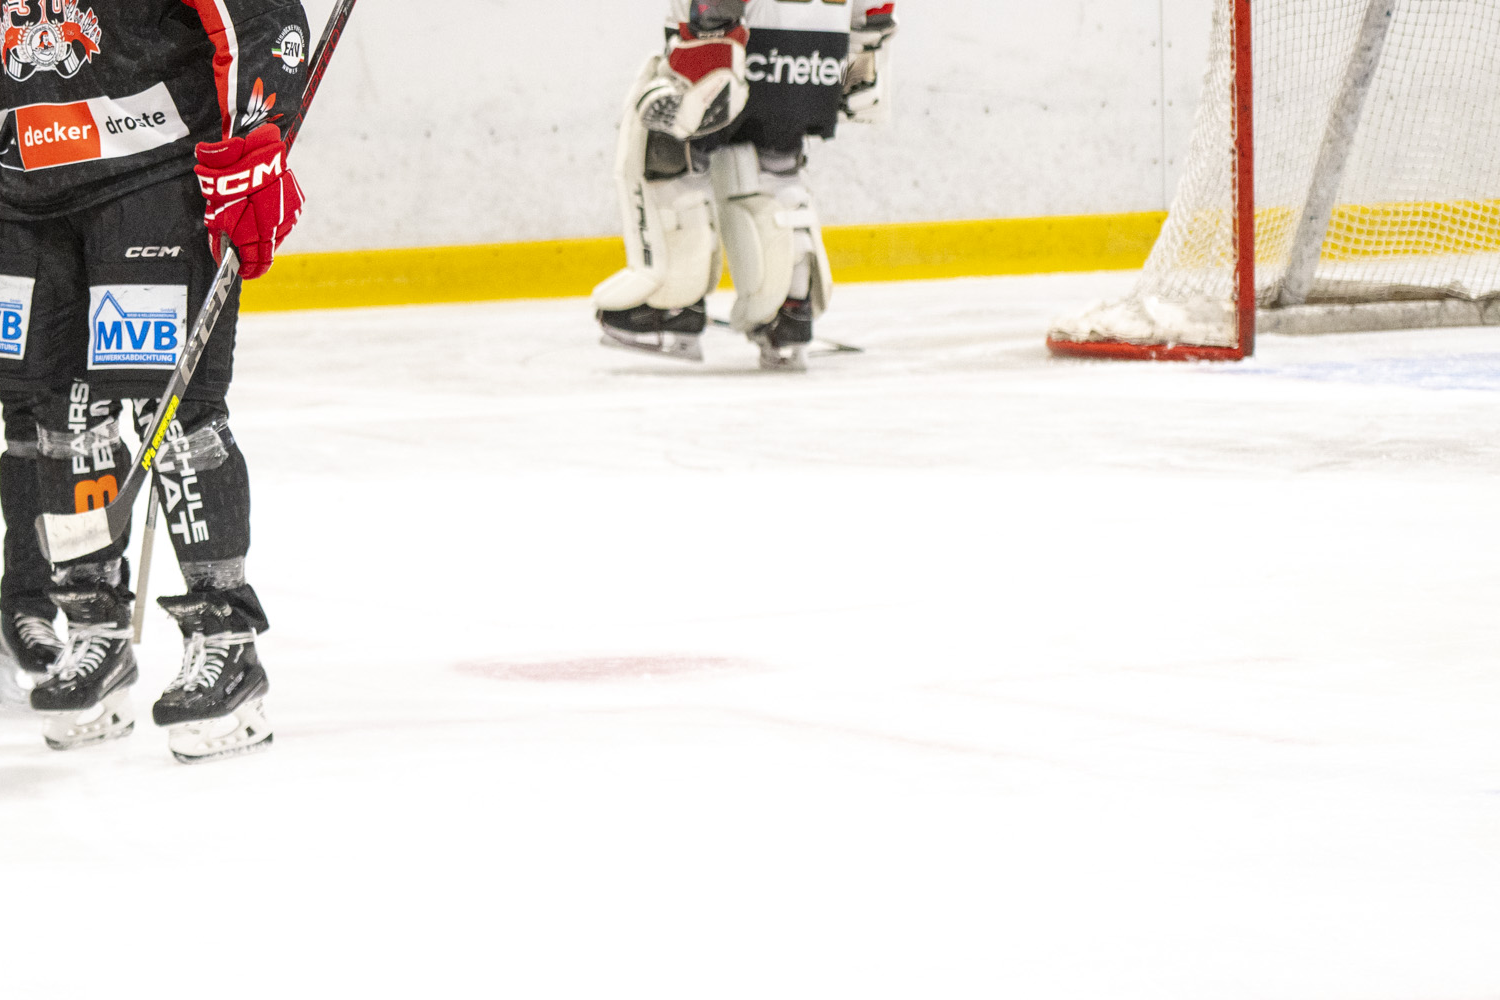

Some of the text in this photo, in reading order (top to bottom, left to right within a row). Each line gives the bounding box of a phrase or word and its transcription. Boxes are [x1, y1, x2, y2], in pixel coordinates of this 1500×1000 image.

[283, 41, 300, 58] EHV
[24, 123, 93, 148] decker
[104, 109, 167, 136] droste
[197, 152, 283, 197] CCM
[126, 245, 182, 259] CCM
[180, 247, 241, 387] CCM
[97, 320, 178, 351] MVB
[95, 354, 173, 362] BAUWERKSABDICHTUNG
